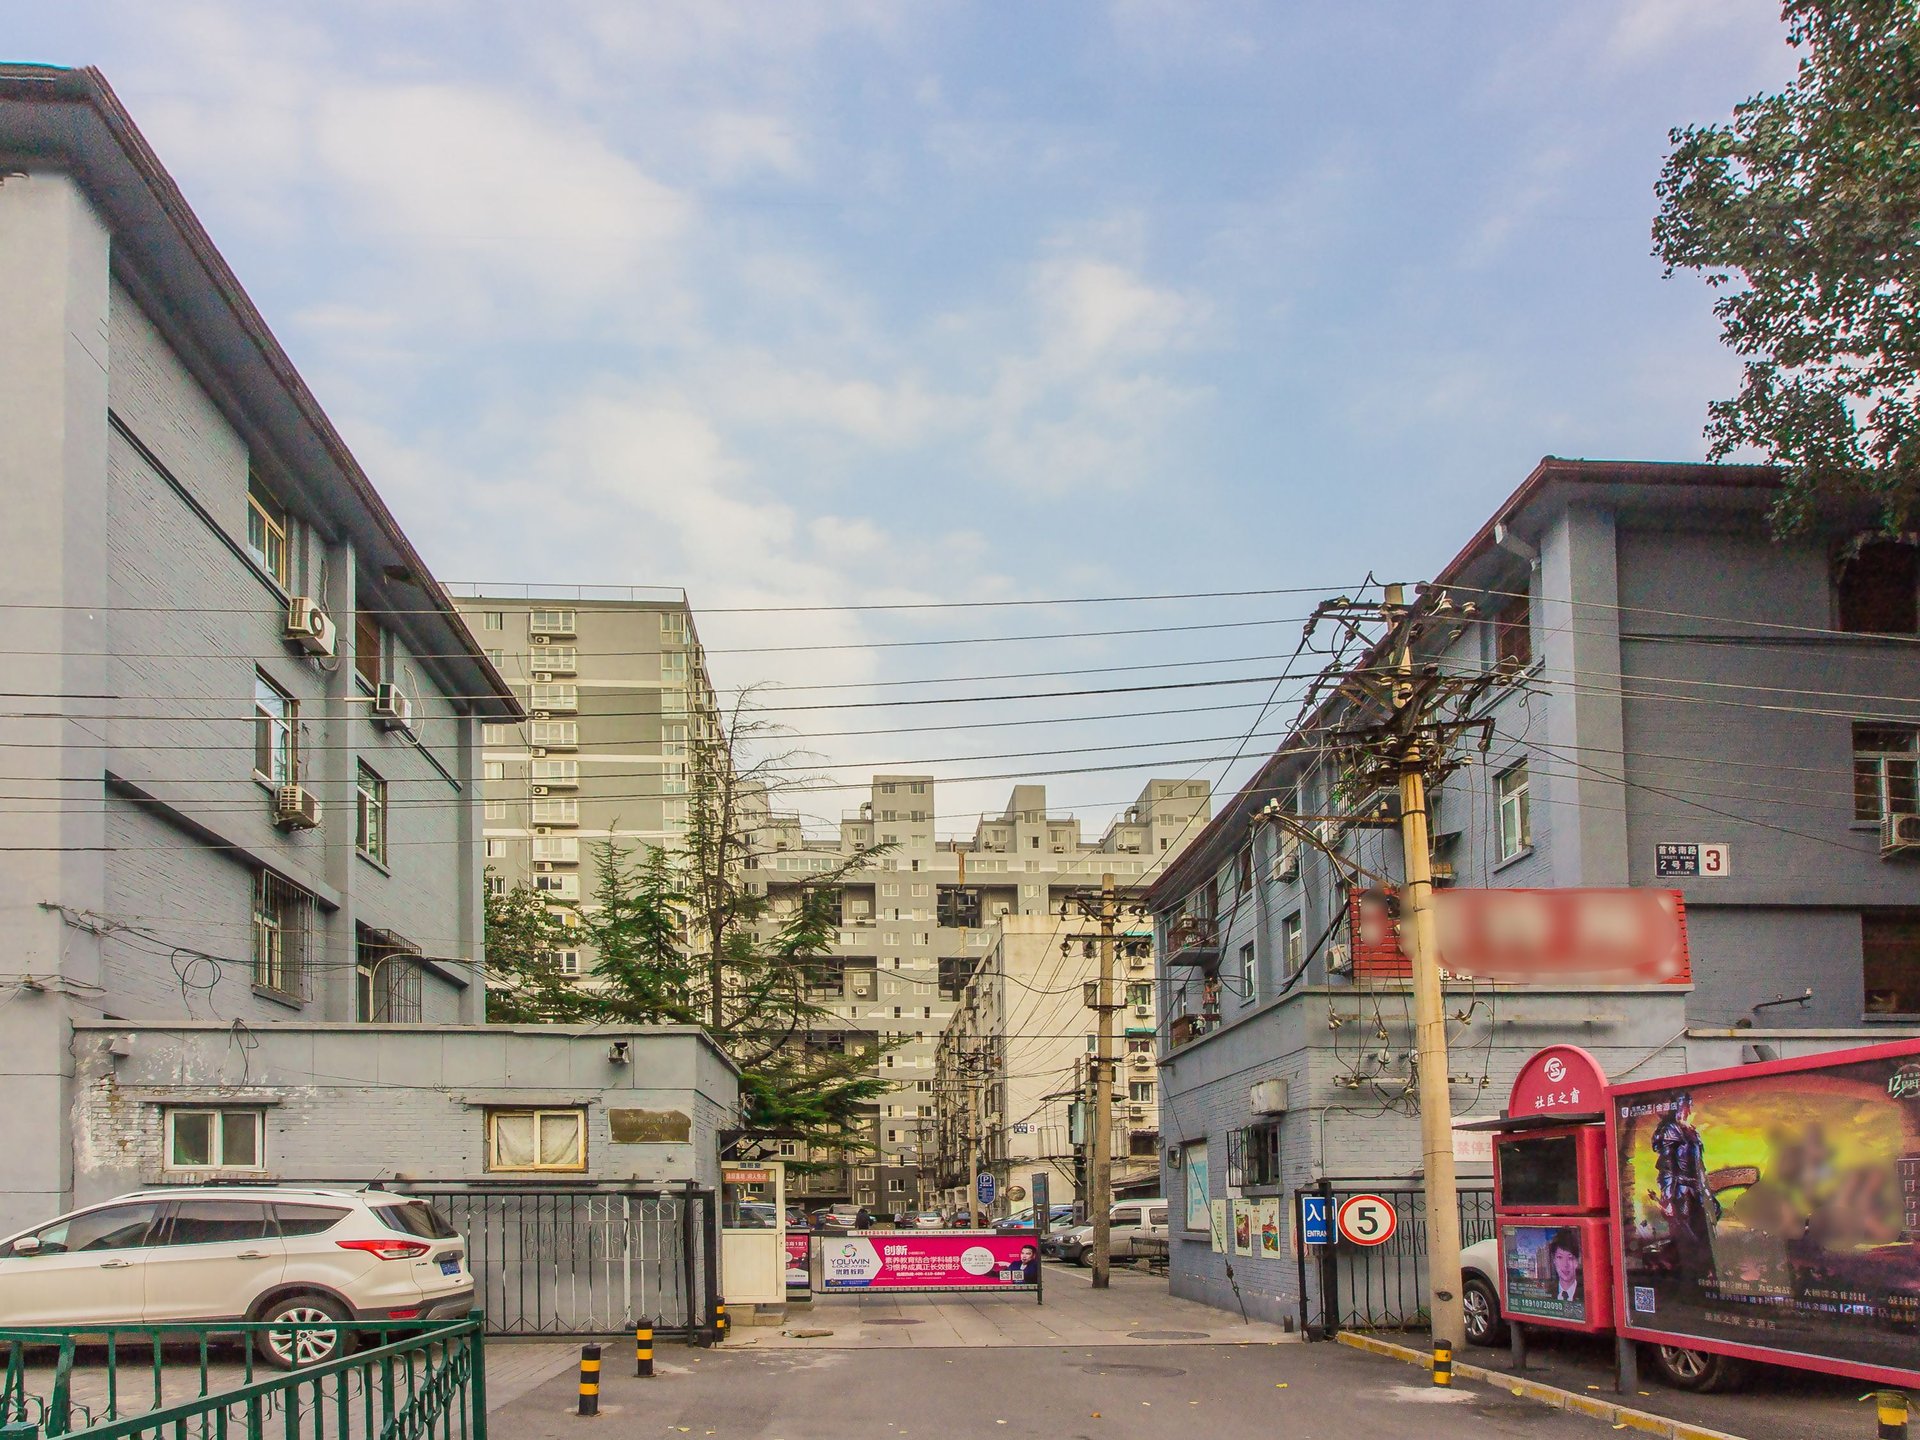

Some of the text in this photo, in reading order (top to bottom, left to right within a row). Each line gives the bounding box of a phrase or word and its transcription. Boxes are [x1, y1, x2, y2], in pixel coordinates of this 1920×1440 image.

[1658, 846, 1697, 855] 首体南路
[1660, 861, 1695, 870] 2号院
[1706, 850, 1720, 871] 3
[1535, 1088, 1580, 1109] 社区之窗
[1357, 1207, 1378, 1235] 5
[884, 1245, 908, 1255] 创新
